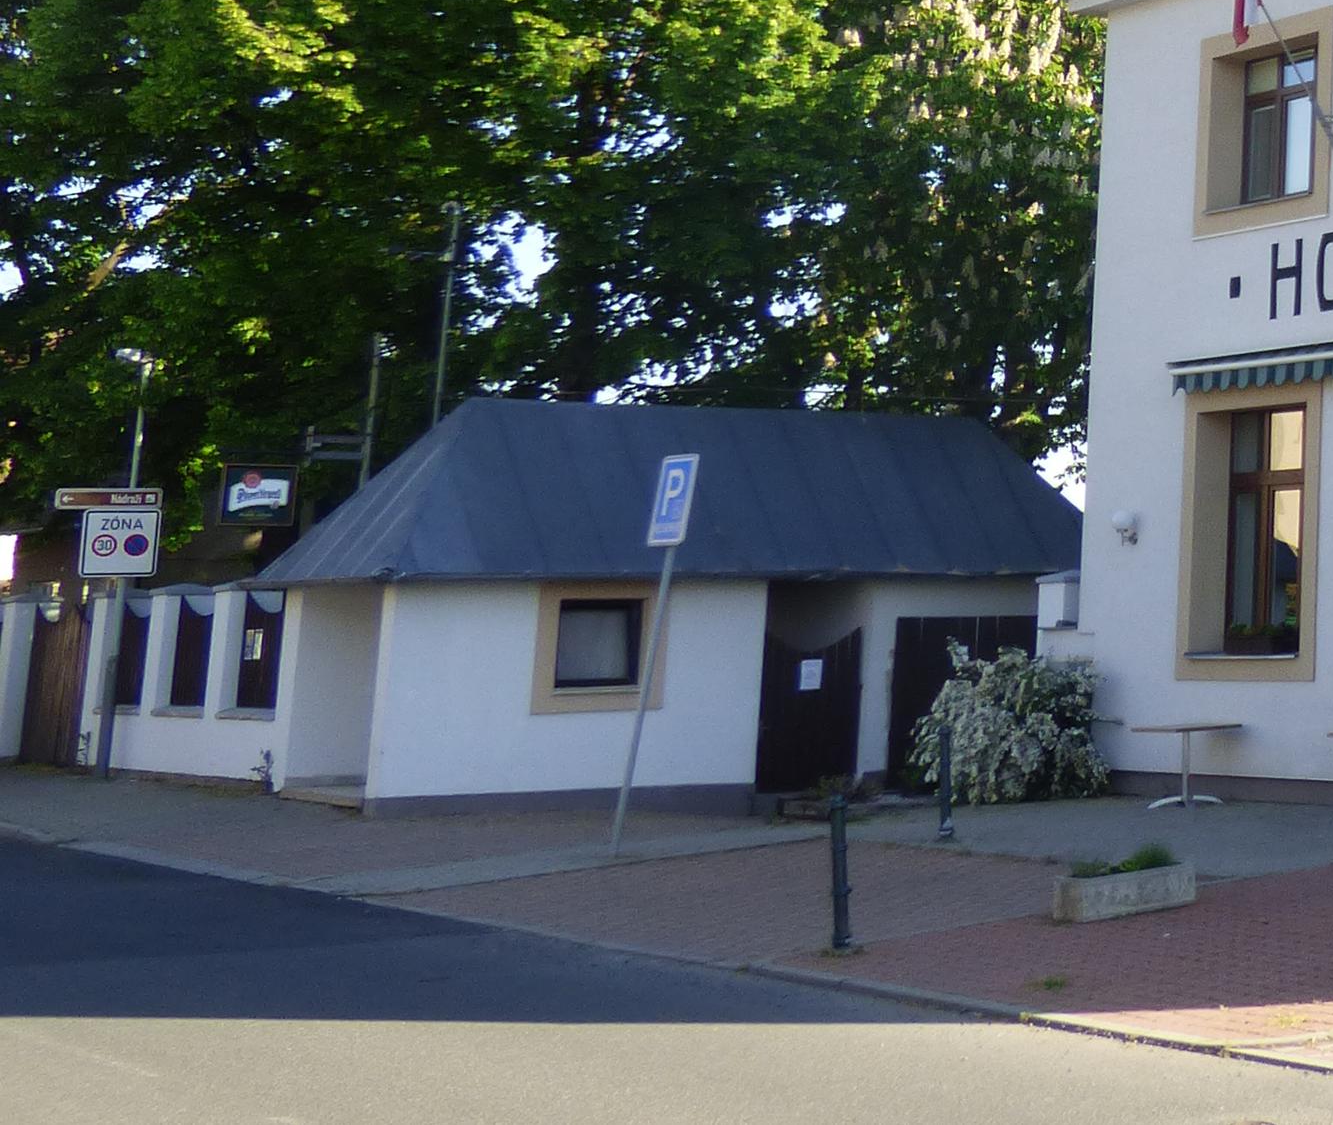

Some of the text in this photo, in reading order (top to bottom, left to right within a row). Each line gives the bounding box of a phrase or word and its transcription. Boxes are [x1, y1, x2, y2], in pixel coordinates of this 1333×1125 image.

[661, 468, 685, 516] P
[101, 516, 144, 530] ZÓNA
[96, 539, 112, 551] 30
